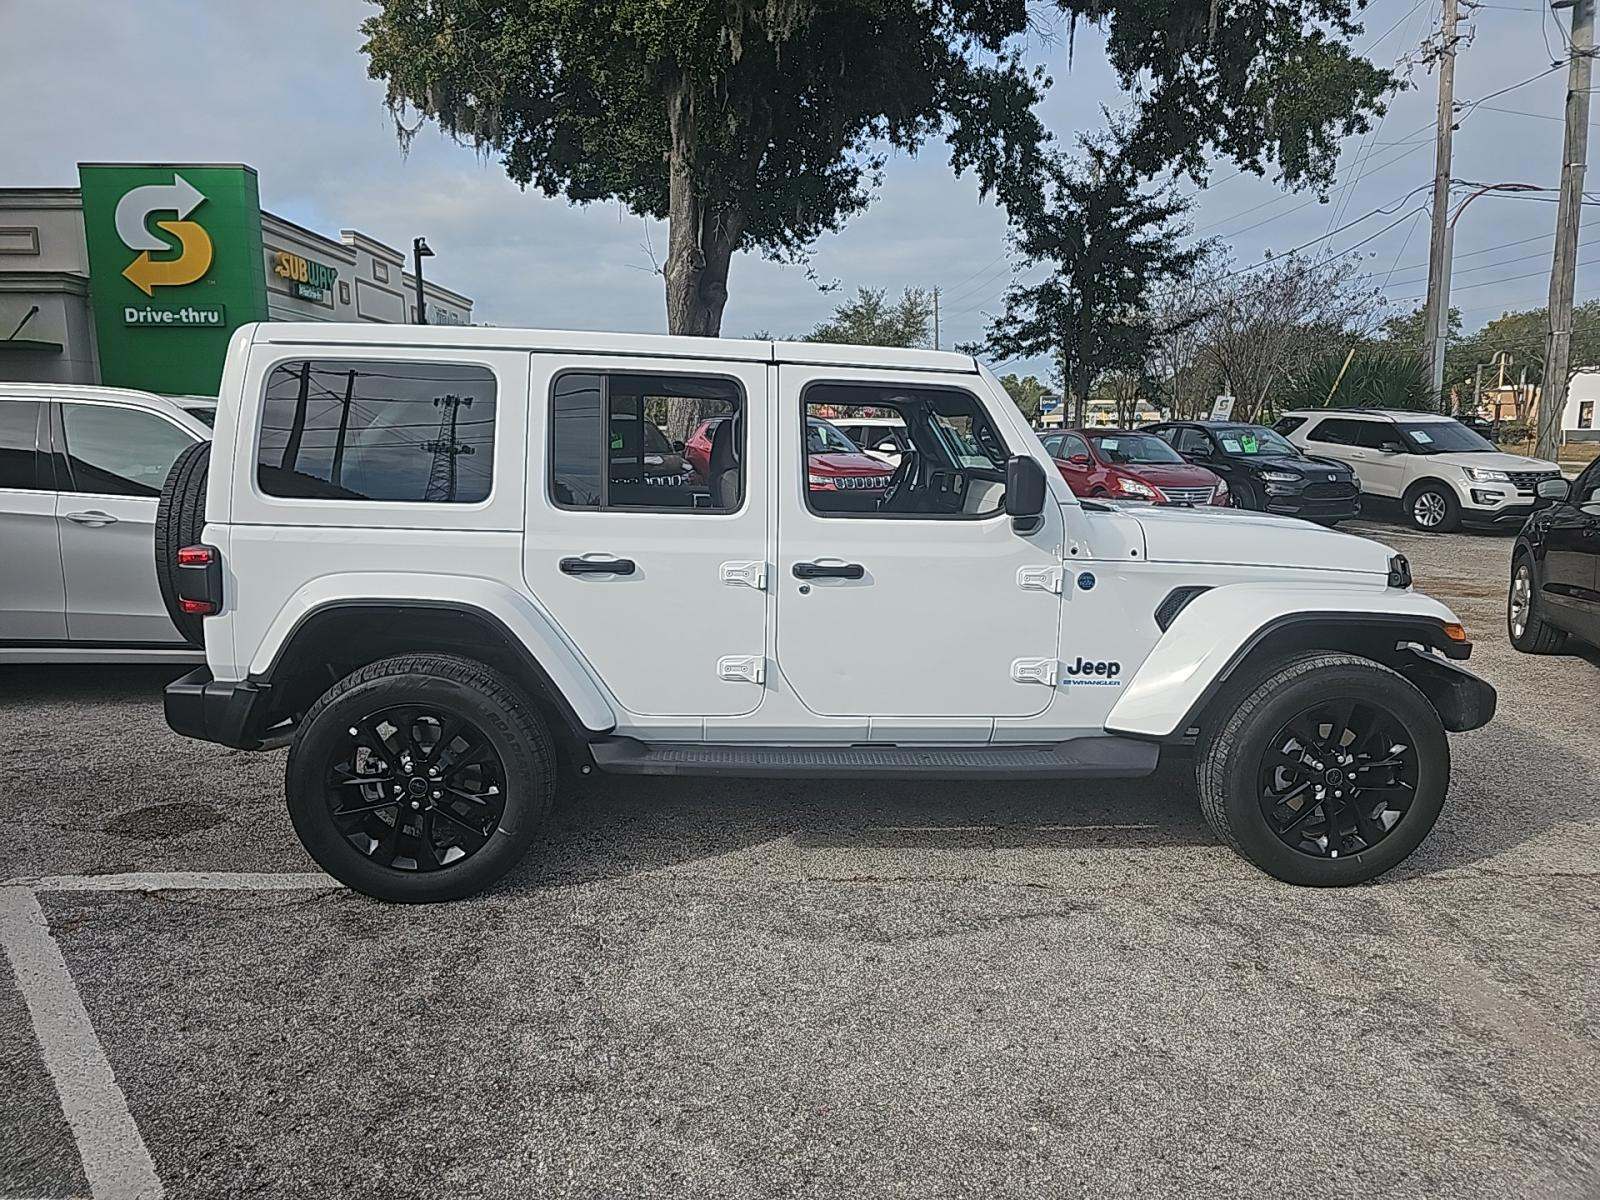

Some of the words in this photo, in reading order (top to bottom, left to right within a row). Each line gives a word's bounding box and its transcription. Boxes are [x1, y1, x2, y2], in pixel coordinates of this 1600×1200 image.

[275, 254, 338, 290] SUBWAY
[124, 307, 219, 323] Drive-thru
[1067, 657, 1121, 679] Jeep
